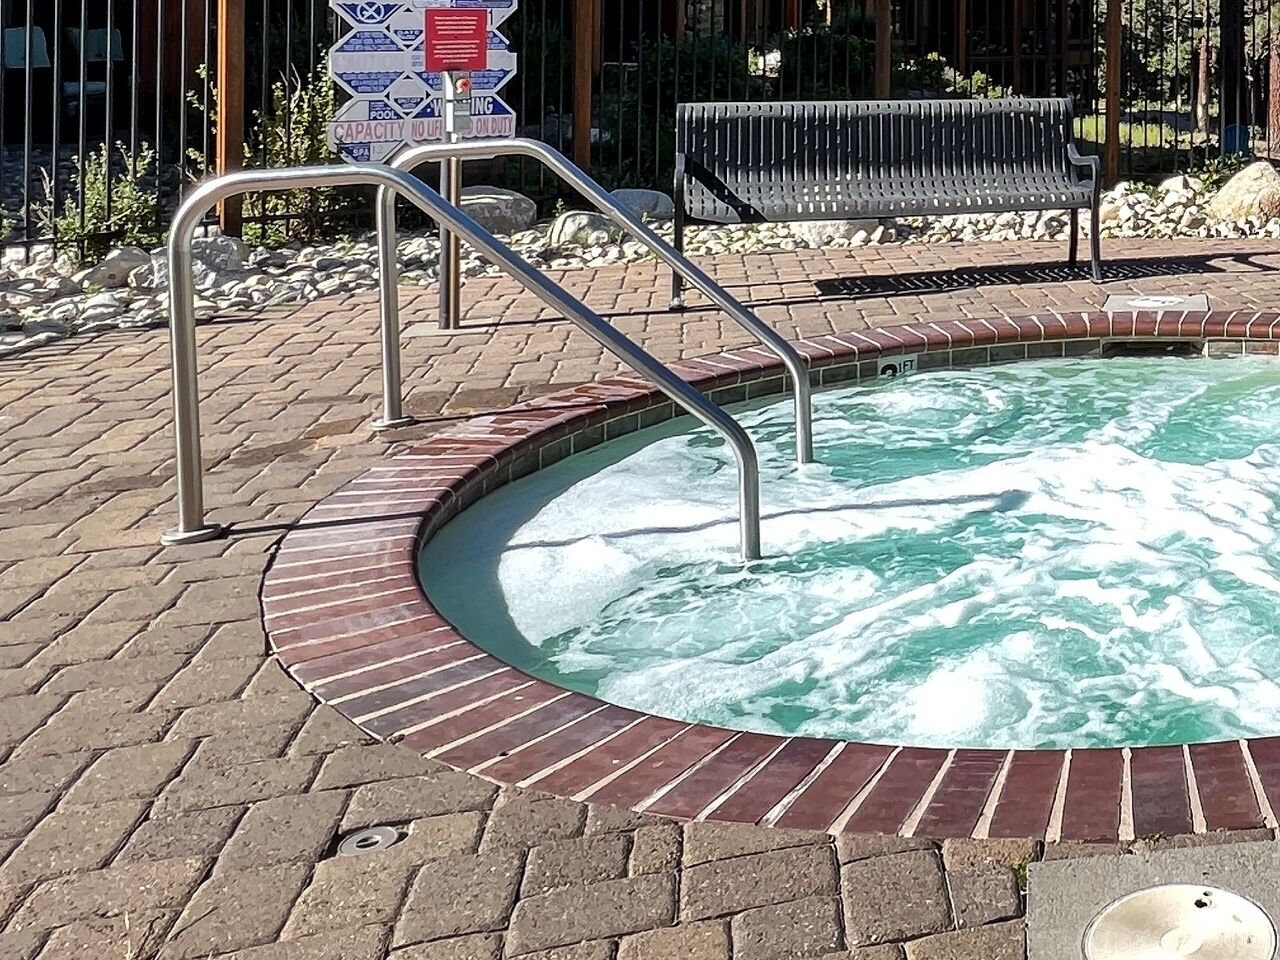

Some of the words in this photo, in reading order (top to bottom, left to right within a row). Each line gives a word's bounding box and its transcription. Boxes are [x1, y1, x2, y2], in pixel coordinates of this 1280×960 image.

[369, 110, 398, 120] POOL
[433, 96, 494, 116] WING
[334, 121, 404, 141] CAPACITY
[411, 121, 424, 138] NO
[476, 119, 489, 134] ON
[491, 116, 513, 134] DUTY
[352, 148, 370, 157] SPA
